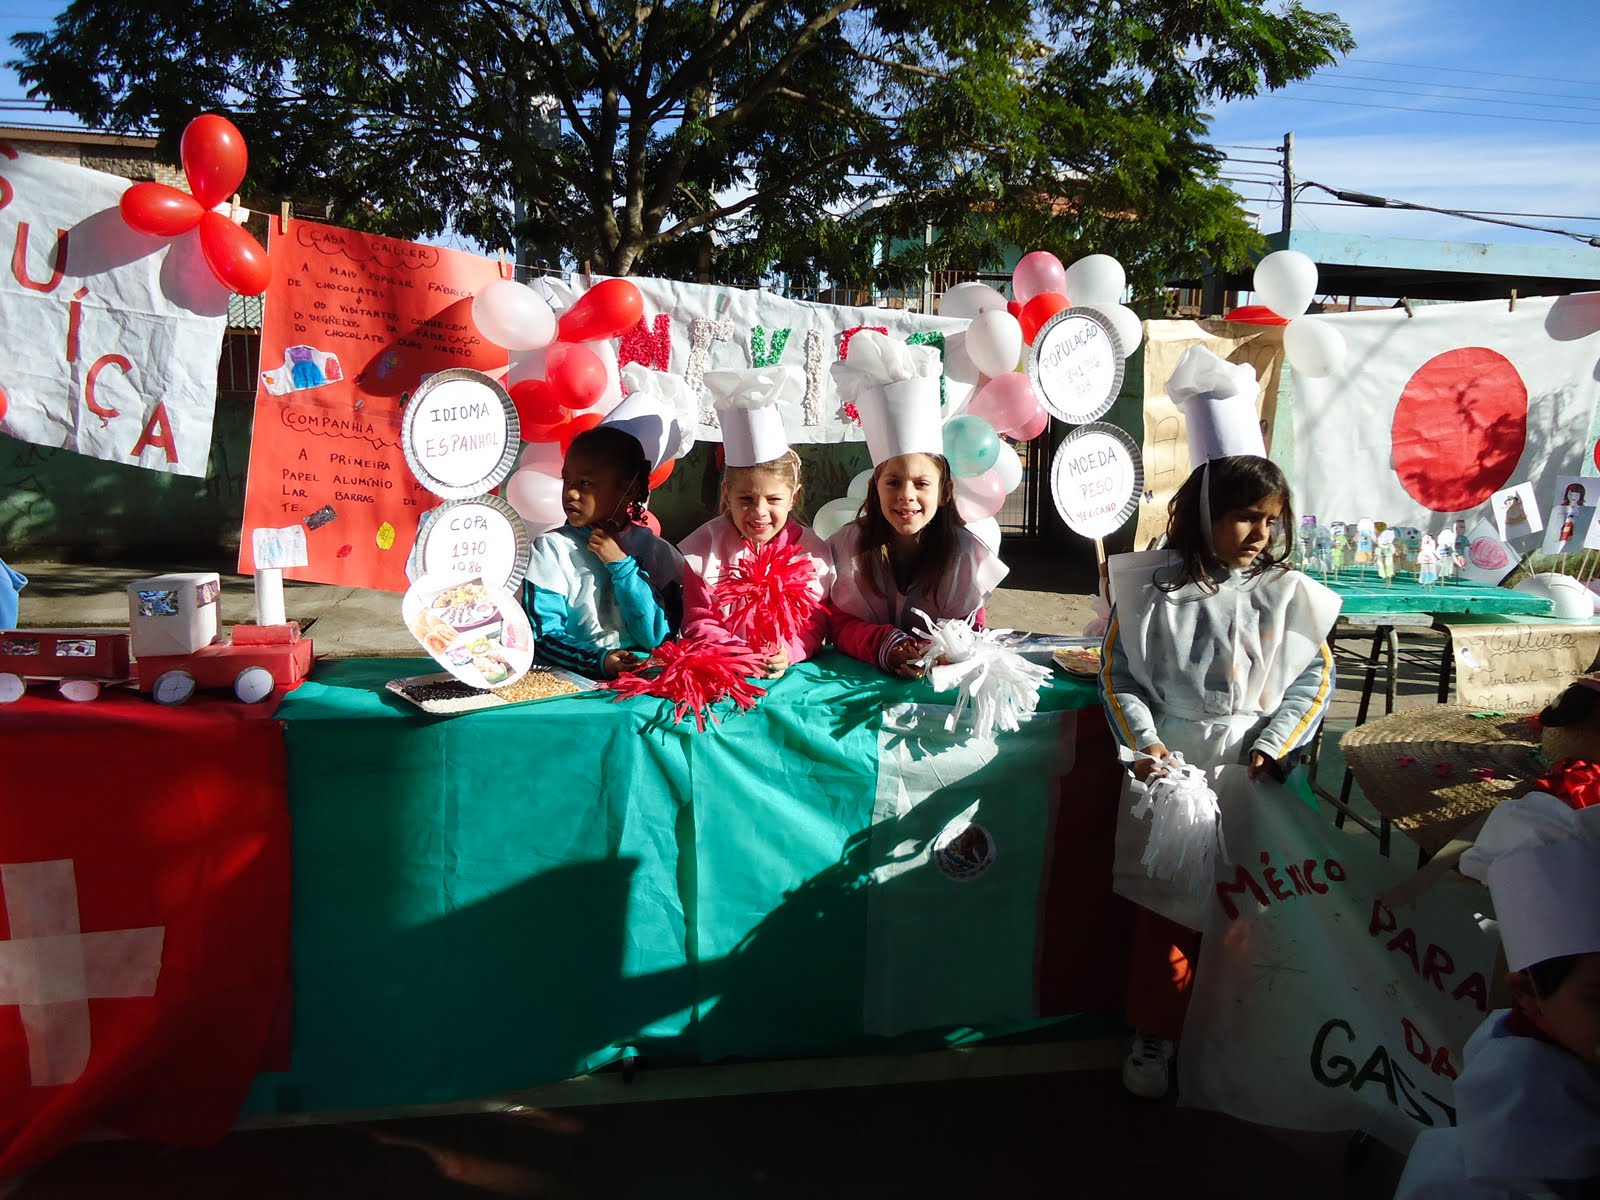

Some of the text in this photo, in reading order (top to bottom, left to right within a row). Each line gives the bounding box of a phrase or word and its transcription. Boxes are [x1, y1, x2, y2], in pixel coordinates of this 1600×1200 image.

[310, 230, 429, 260] CASA CAILLER
[302, 263, 309, 272] A
[329, 267, 357, 278] MAIS
[368, 272, 413, 289] POPULAR
[287, 279, 385, 298] DE CHOCOLATES
[293, 311, 304, 320] OS
[309, 314, 361, 328] SEGREDOS
[314, 301, 327, 309] OS
[340, 305, 400, 322] VISITANTES
[295, 324, 306, 333] DO
[325, 329, 385, 343] CHOCOLATE
[1041, 322, 1098, 369] POPULAÇÃO
[286, 412, 375, 434] COMPANHIA
[430, 402, 490, 423] IDIOMA
[426, 430, 499, 458] ESPANHOL
[298, 448, 391, 471] A PRIMEIRA
[1068, 446, 1118, 478] MOEDA
[282, 468, 320, 483] PAPEL
[333, 473, 394, 490] ALUMÍNIO
[1079, 476, 1114, 500] PESO
[281, 484, 418, 506] LAR BARRAS DE
[450, 515, 488, 532] COPA
[1076, 502, 1117, 523] MEXICANO
[452, 541, 487, 558] 1970
[1490, 625, 1578, 652] Cultura
[1481, 668, 1538, 687] Festival
[1216, 851, 1348, 920] MÉXICO
[1368, 898, 1489, 1013] PARA
